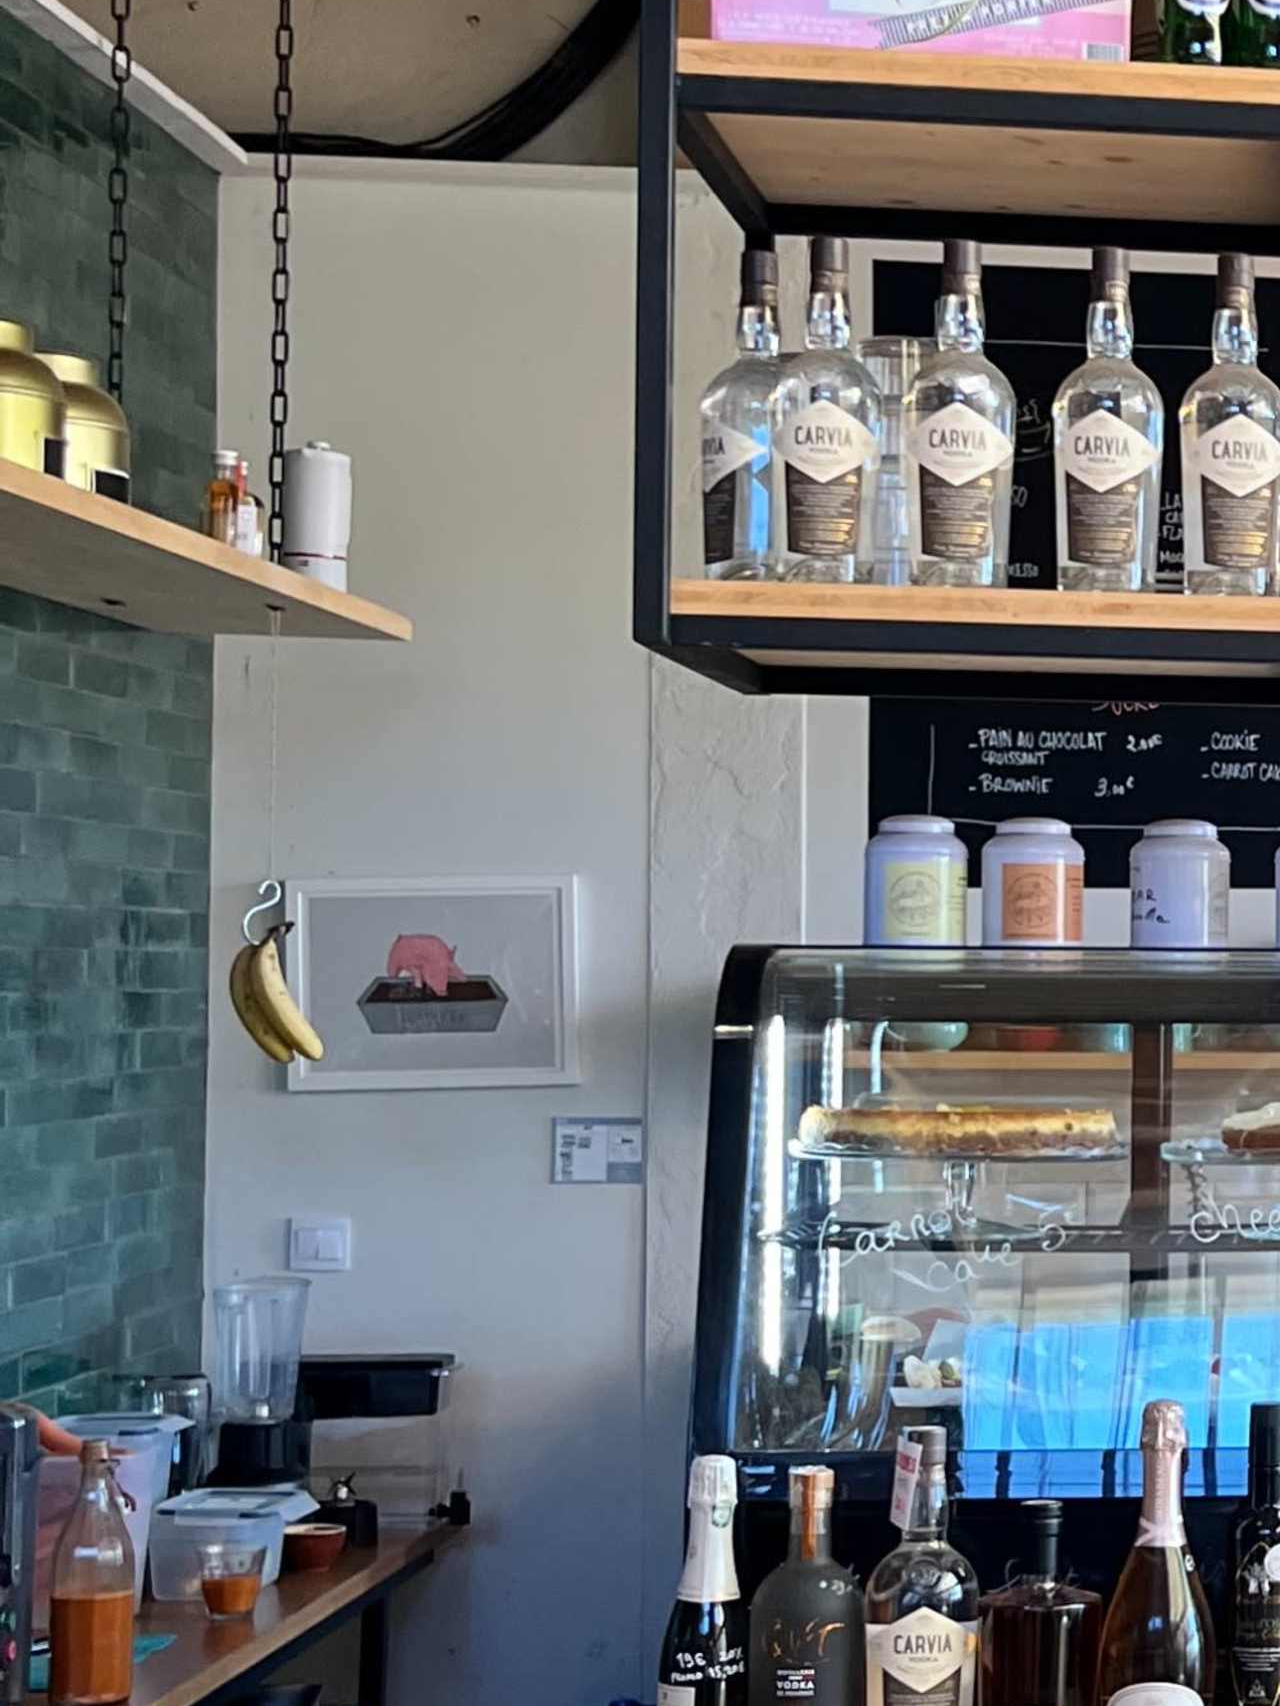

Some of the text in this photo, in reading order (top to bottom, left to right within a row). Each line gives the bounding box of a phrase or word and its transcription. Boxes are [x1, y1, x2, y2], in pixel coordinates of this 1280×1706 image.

[795, 425, 851, 447] CARVIA
[929, 427, 987, 450] CARVIA
[1074, 436, 1131, 457] CARVIA
[1211, 440, 1269, 462] CARVIA
[978, 728, 1012, 748] PAIN
[1017, 730, 1034, 749] AU
[1038, 730, 1107, 751] CHOCOLAT
[1210, 729, 1261, 751] COOKIE
[979, 773, 1053, 793] BROWNIE
[893, 1633, 952, 1655] CARVIA
